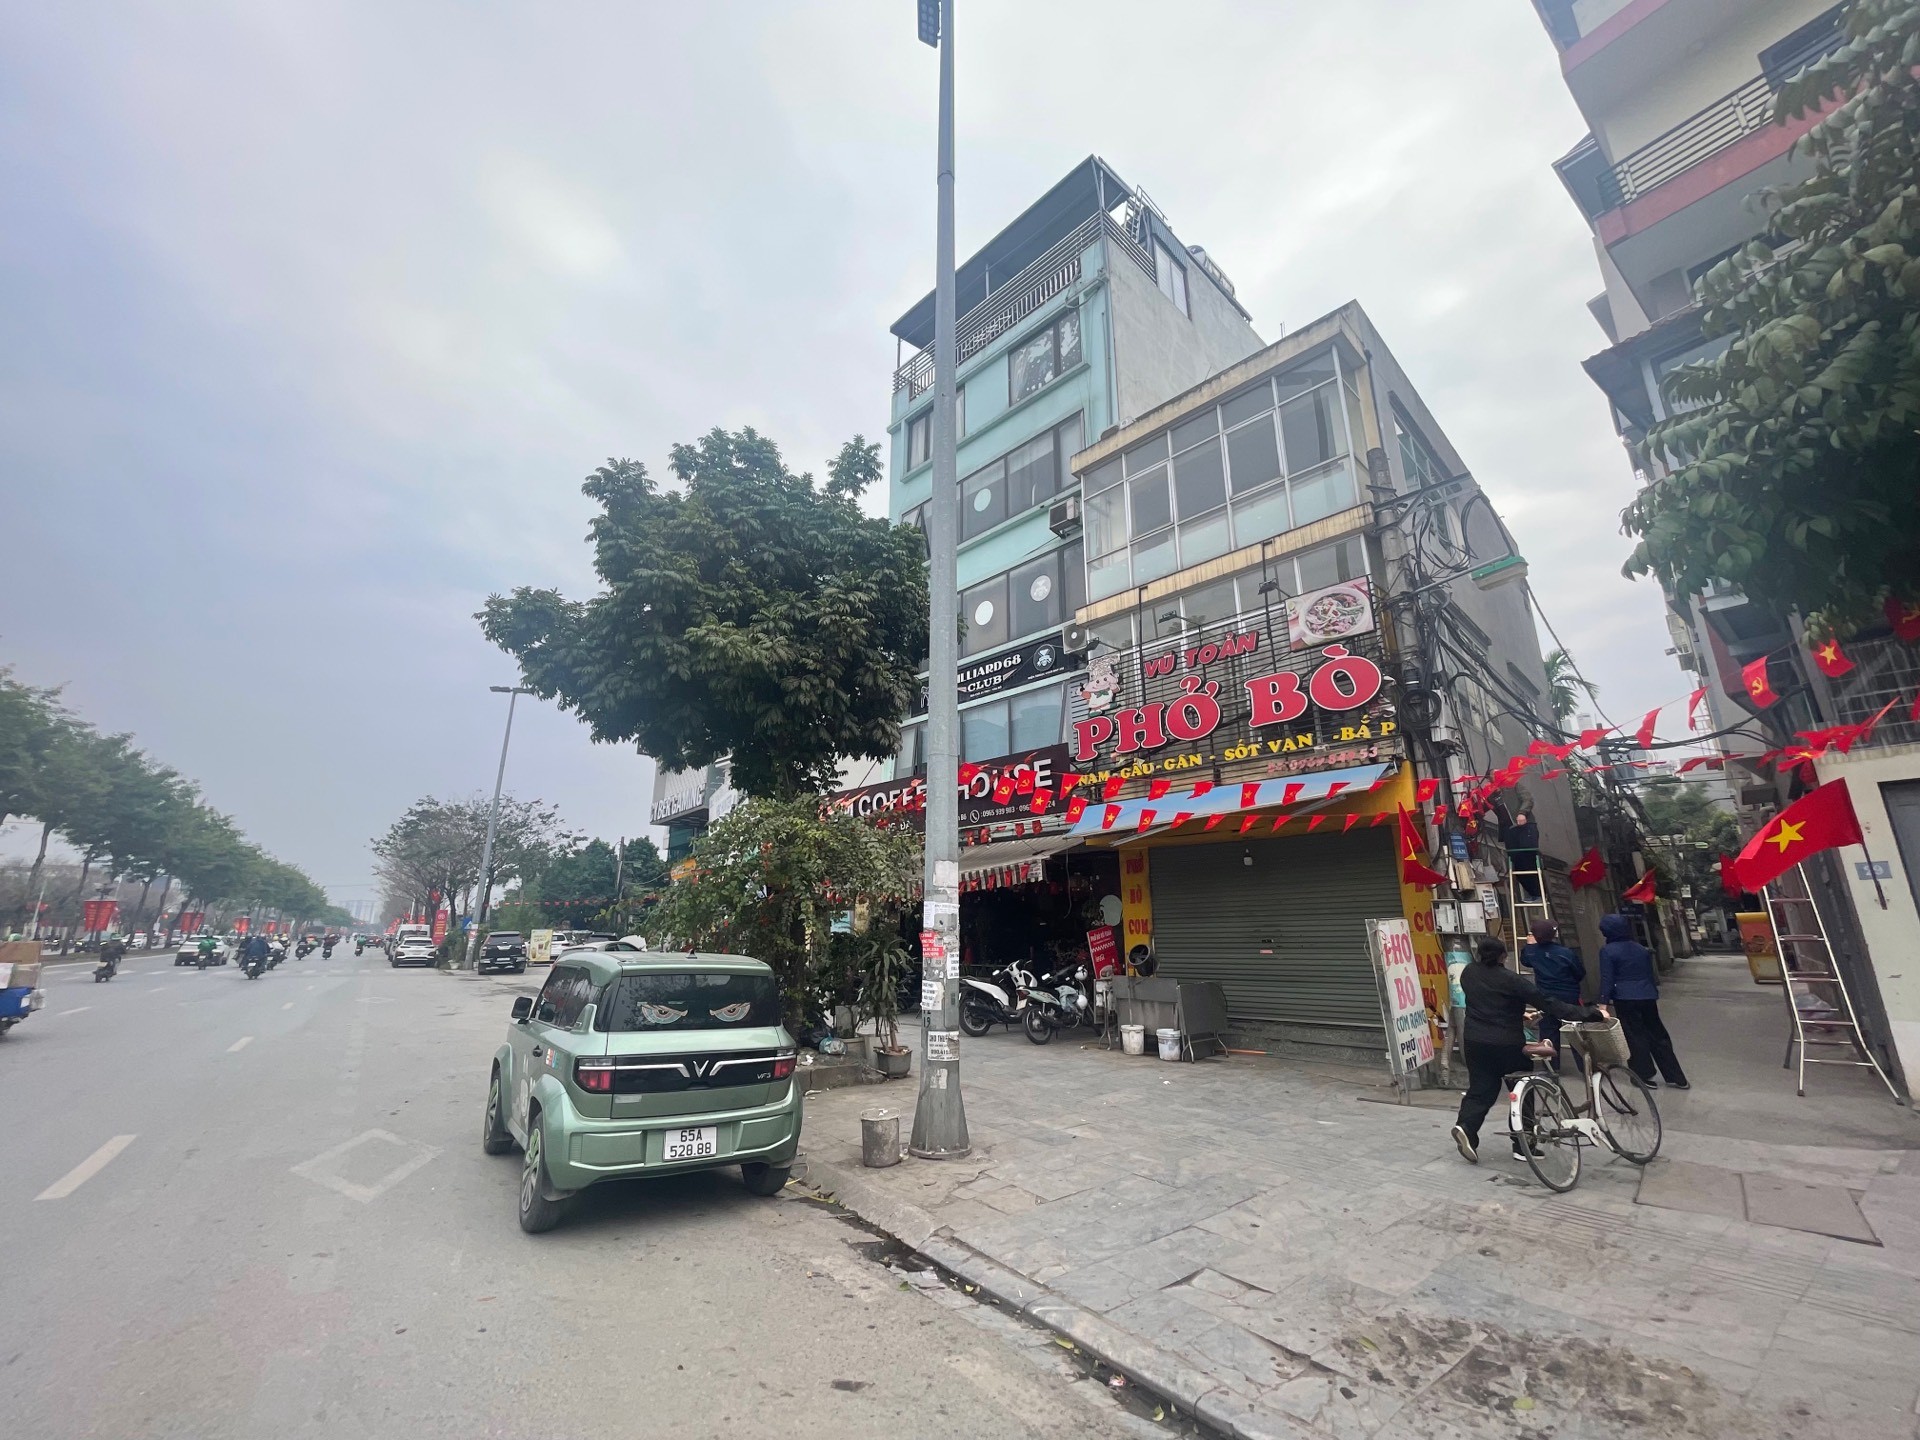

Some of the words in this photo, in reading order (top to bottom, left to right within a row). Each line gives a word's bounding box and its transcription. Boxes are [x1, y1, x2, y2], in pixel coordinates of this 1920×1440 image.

[968, 675, 1002, 692] CLUB
[1072, 675, 1222, 763] PHỞ
[1244, 643, 1382, 729] BÒ
[1413, 911, 1435, 933] CO
[1384, 921, 1412, 967] PHỞ
[1394, 966, 1416, 1010] BÒ
[1400, 1033, 1416, 1056] PHỞ
[680, 1129, 703, 1143] 65A
[669, 1142, 712, 1158] 528.88
